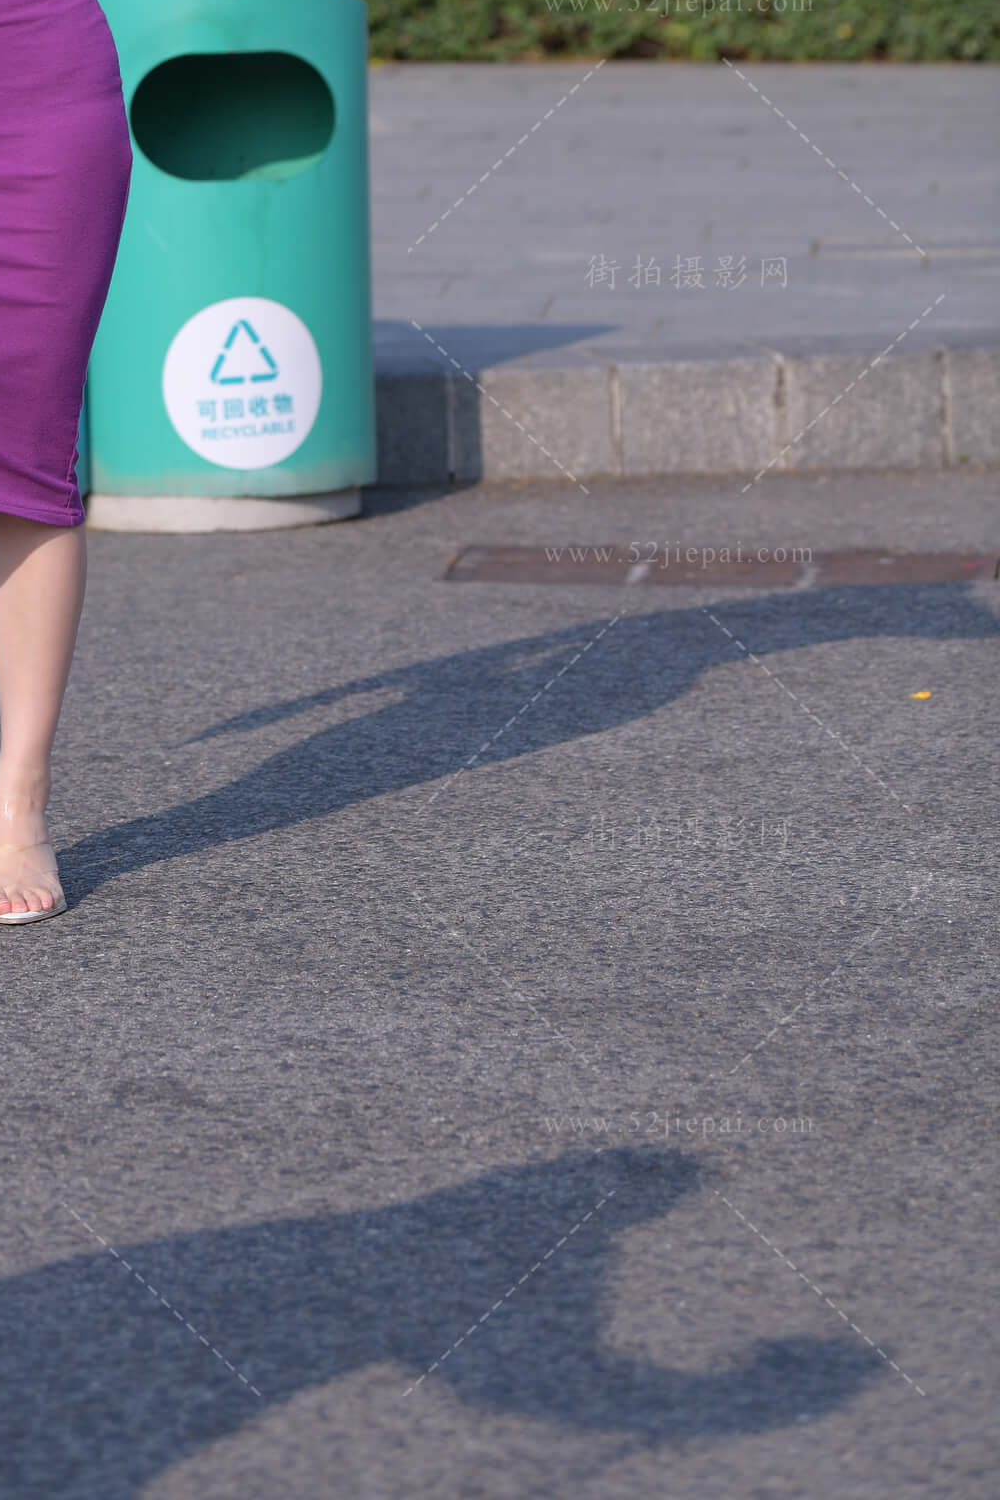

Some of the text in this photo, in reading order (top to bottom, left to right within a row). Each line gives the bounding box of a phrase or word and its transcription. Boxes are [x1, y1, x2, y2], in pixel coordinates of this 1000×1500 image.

[197, 394, 294, 422] 可回收物
[202, 418, 295, 440] RECYCLABLE
